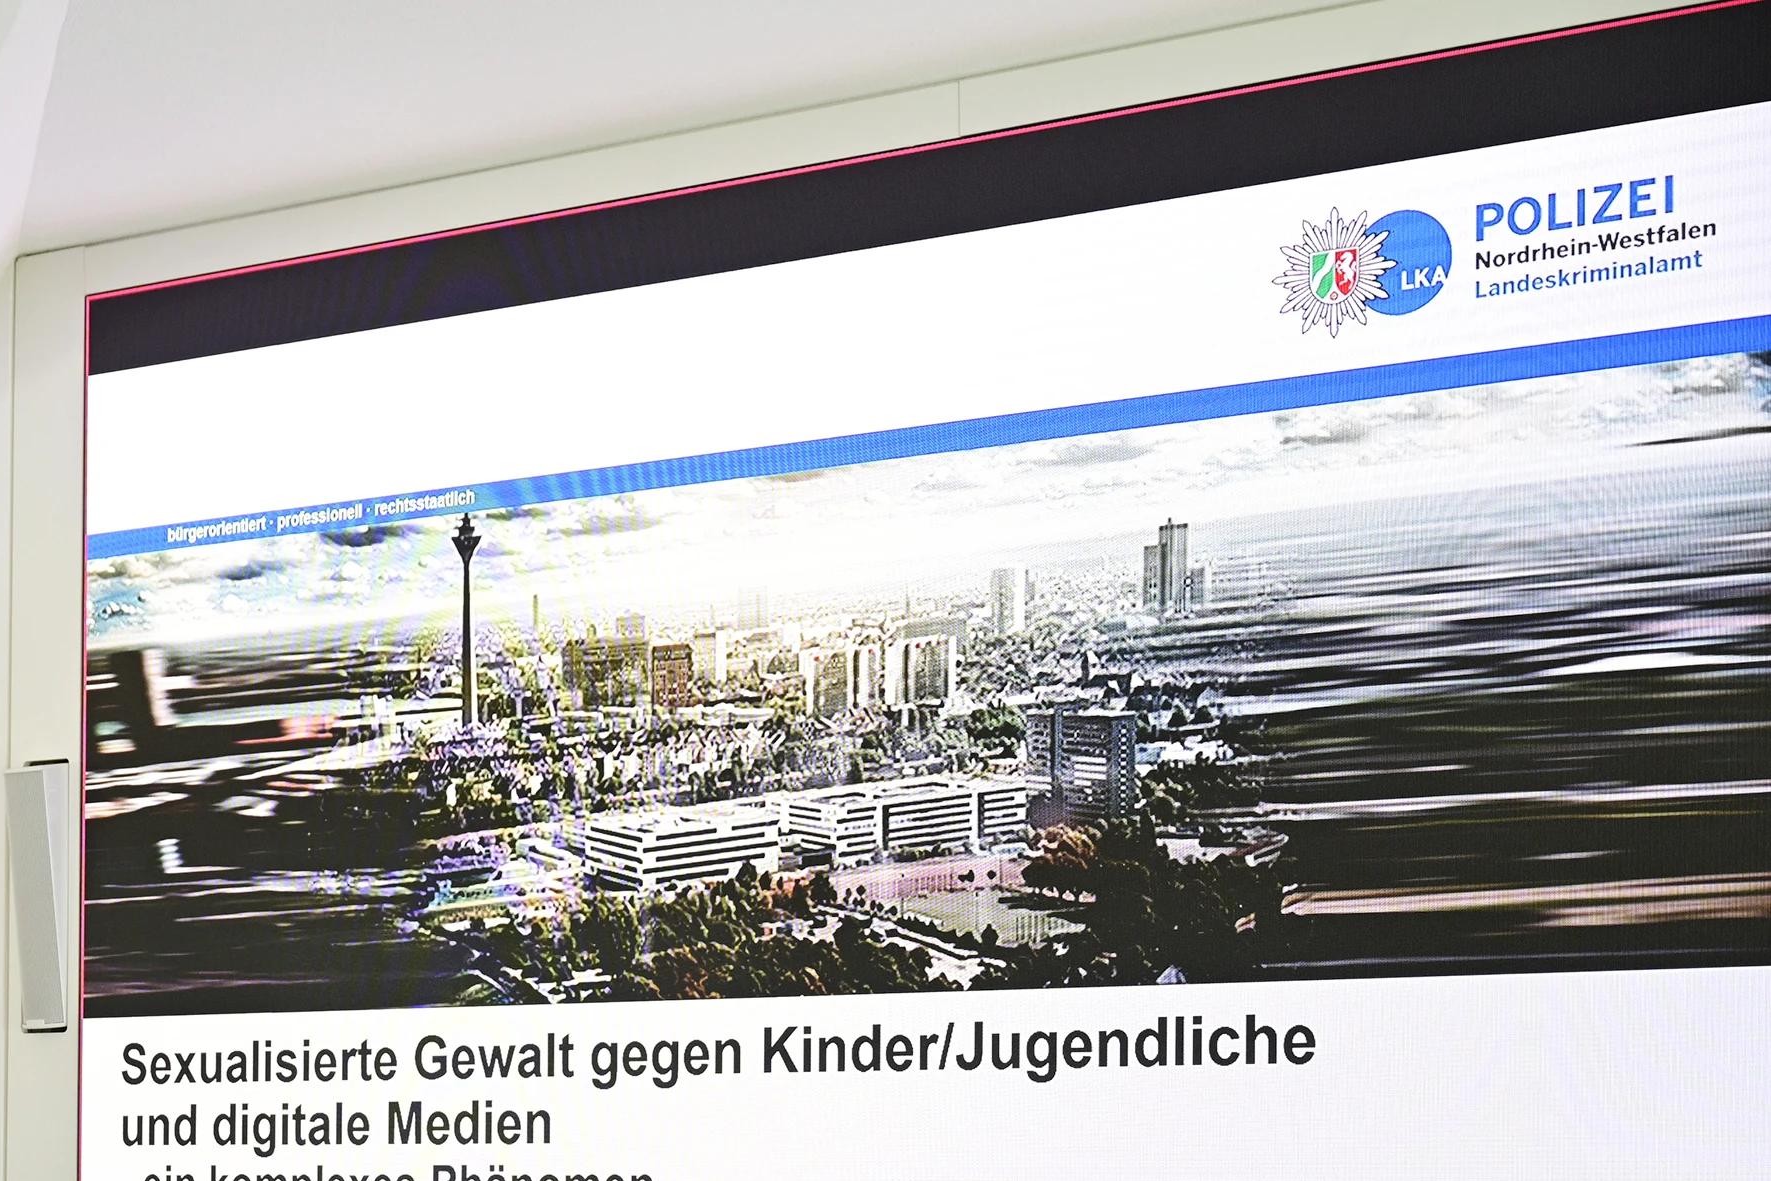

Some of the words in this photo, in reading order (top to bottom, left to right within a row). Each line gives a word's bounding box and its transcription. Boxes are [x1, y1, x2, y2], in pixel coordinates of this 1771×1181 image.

[1475, 175, 1674, 242] POLIZEI
[1475, 220, 1717, 270] Nordrhein-Westfalen
[1400, 265, 1448, 291] LKA
[1475, 250, 1703, 299] Landeskriminalamt
[167, 516, 267, 543] bürgerorientiert
[276, 504, 363, 532] professionell
[374, 489, 476, 517] rechtsstaatlich
[122, 1039, 398, 1086] Sexualisierte
[415, 1032, 574, 1080] Gewalt
[590, 1036, 742, 1090] gegen
[763, 1014, 1316, 1083] Kinder/Jugendliche
[121, 1105, 197, 1146] und
[213, 1102, 370, 1158] digitale
[388, 1101, 552, 1145] Medien
